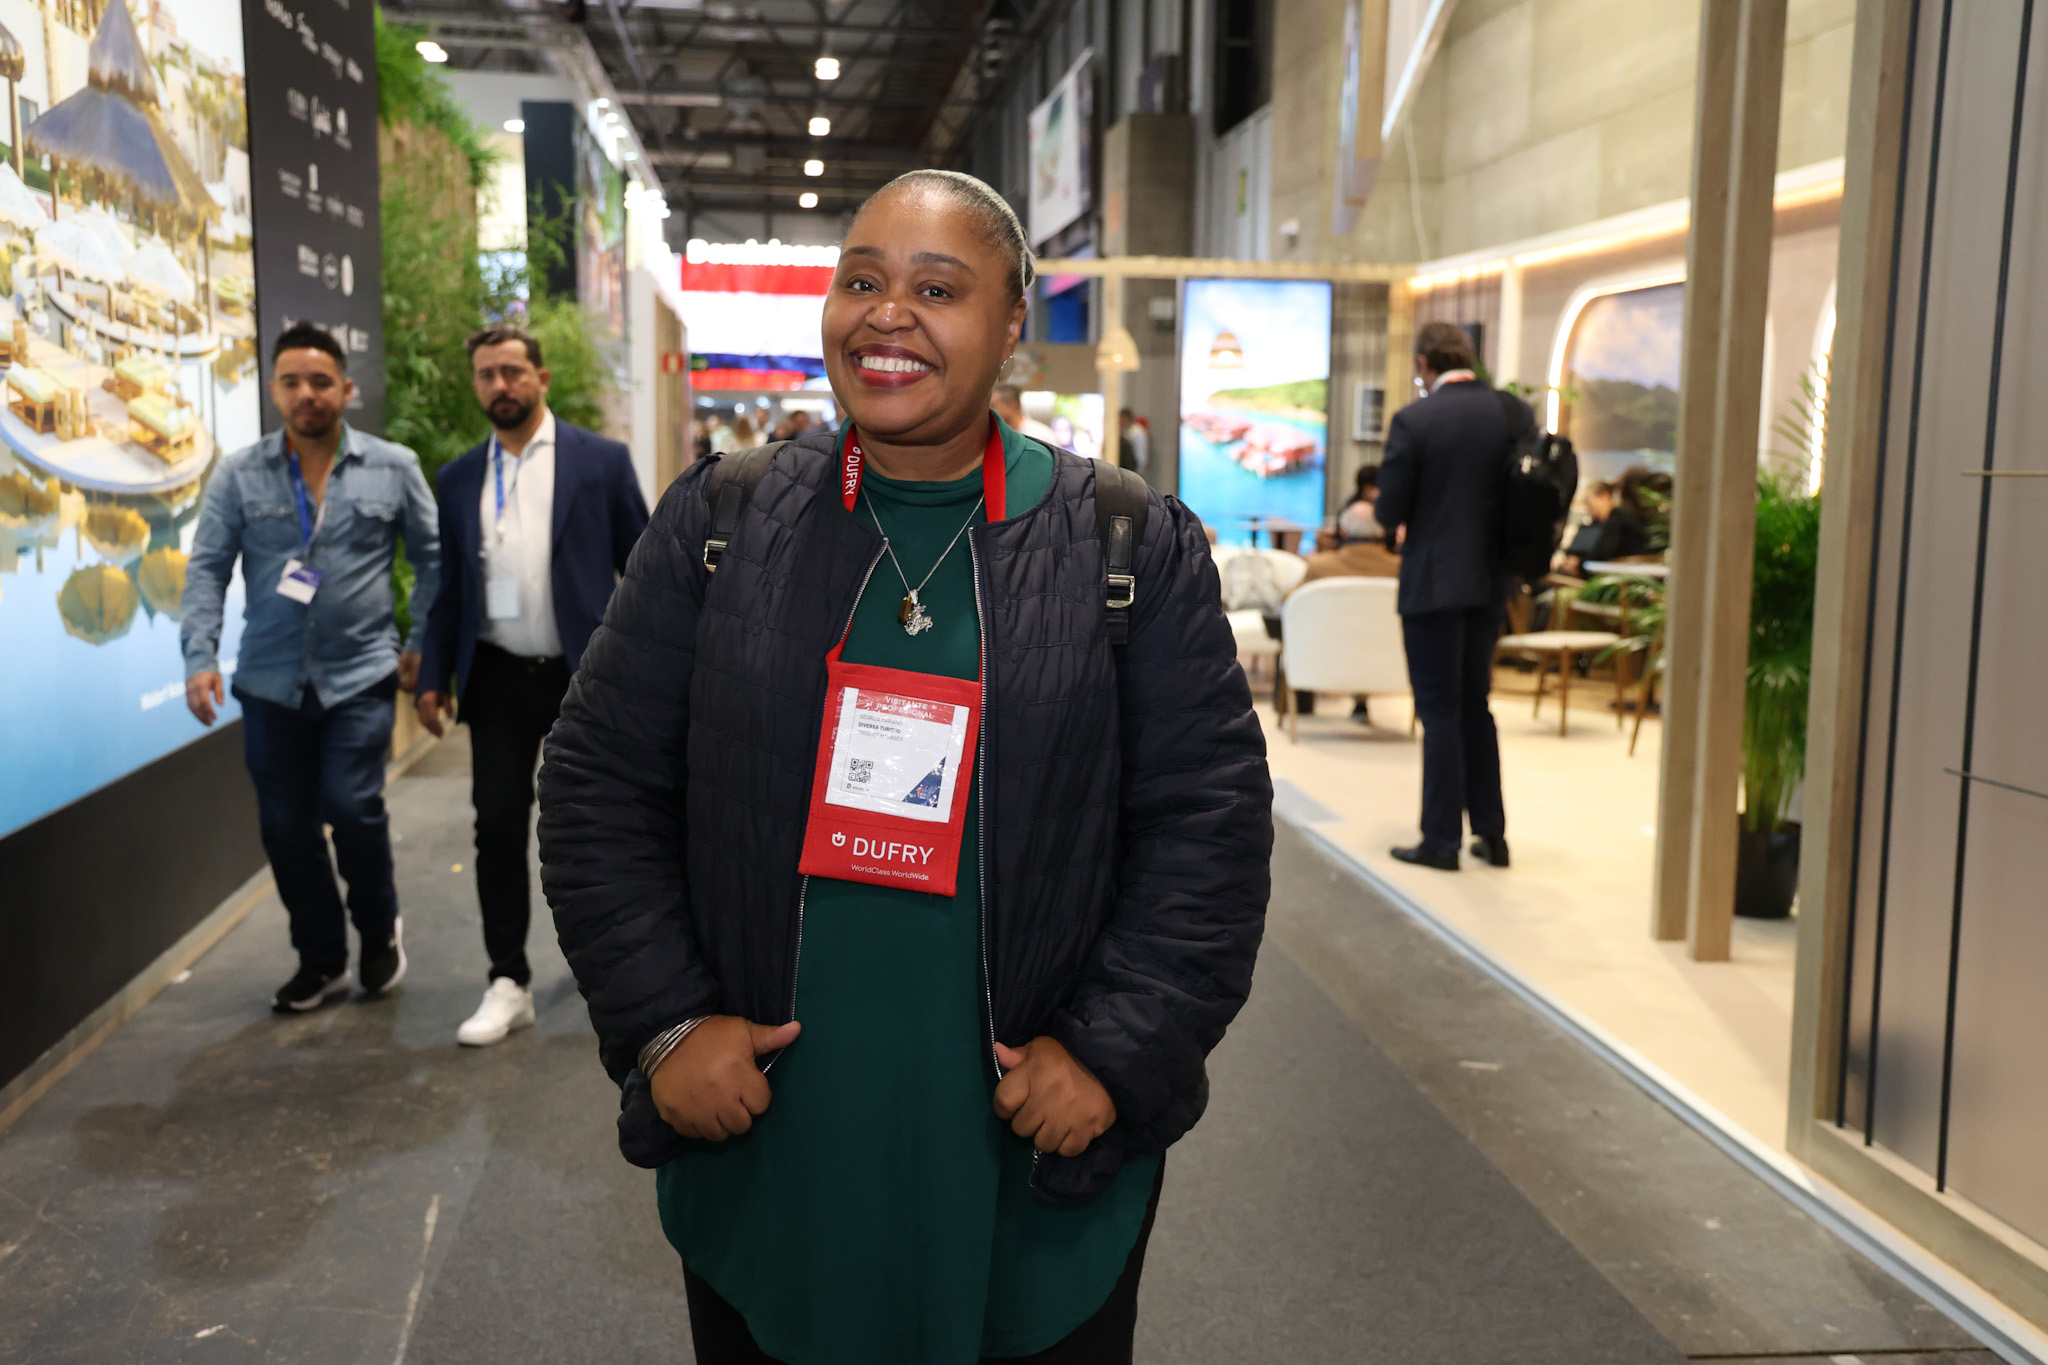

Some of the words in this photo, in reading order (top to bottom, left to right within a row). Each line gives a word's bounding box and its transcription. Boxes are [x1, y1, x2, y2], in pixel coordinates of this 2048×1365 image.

[845, 455, 860, 495] DUFRY
[885, 696, 928, 710] VISITANTE
[877, 703, 934, 719] PROFESIONAL
[858, 722, 879, 731] DIVERSA
[880, 725, 902, 734] TURIO
[852, 837, 935, 865] DUFRY
[851, 863, 891, 876] WorldClass
